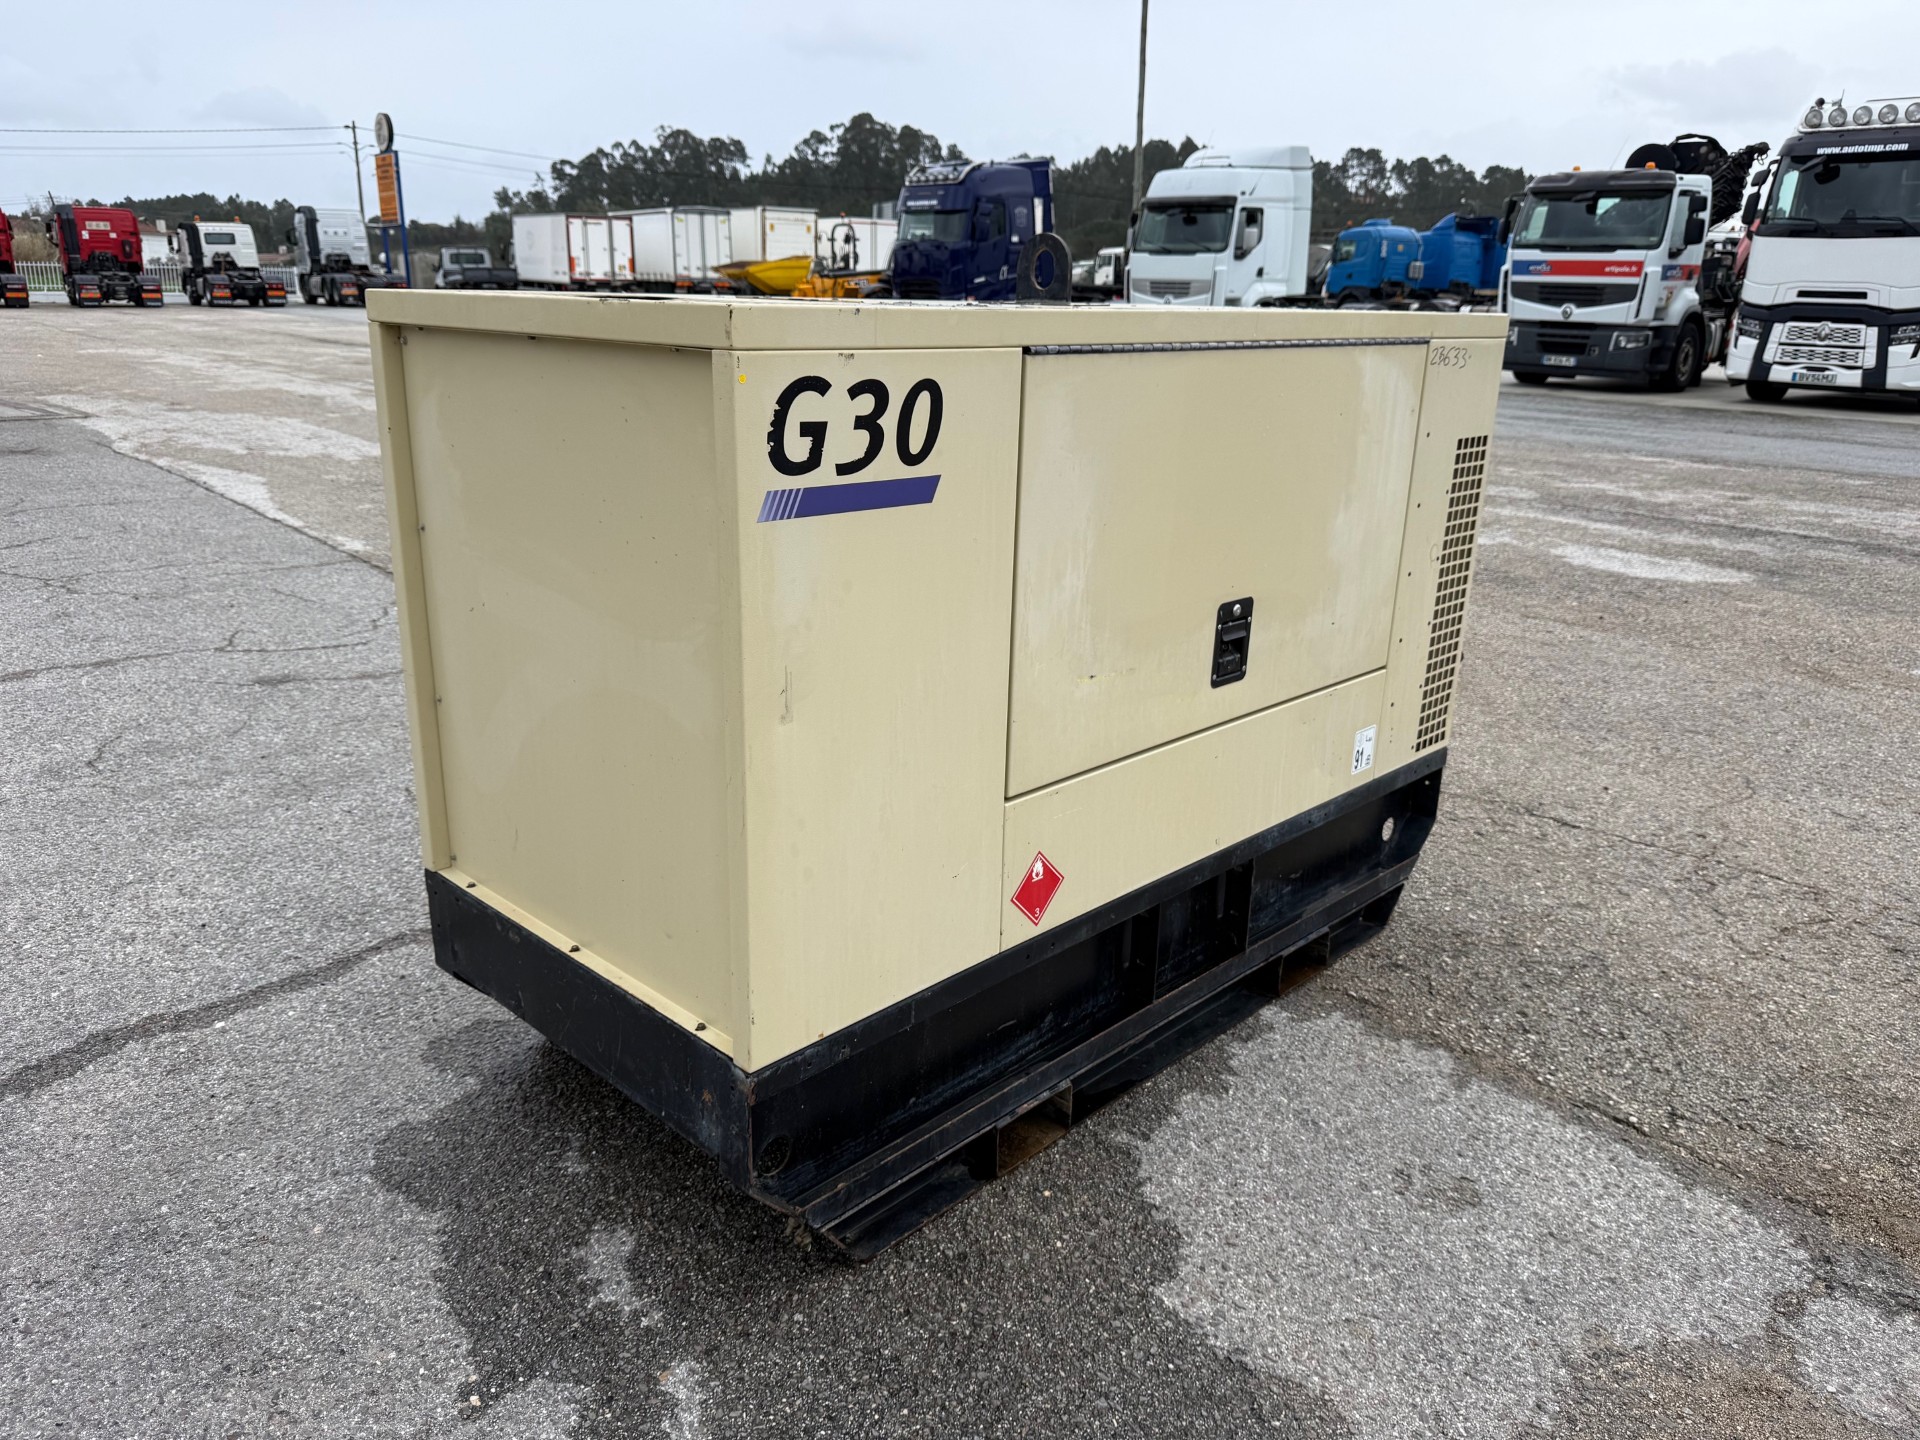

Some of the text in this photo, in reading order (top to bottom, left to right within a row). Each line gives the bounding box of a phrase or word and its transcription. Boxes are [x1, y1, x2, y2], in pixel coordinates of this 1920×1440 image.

[1816, 143, 1909, 155] www.autotmp.com
[766, 374, 944, 477] G30
[1354, 747, 1364, 770] 91
[1034, 907, 1040, 917] 3
